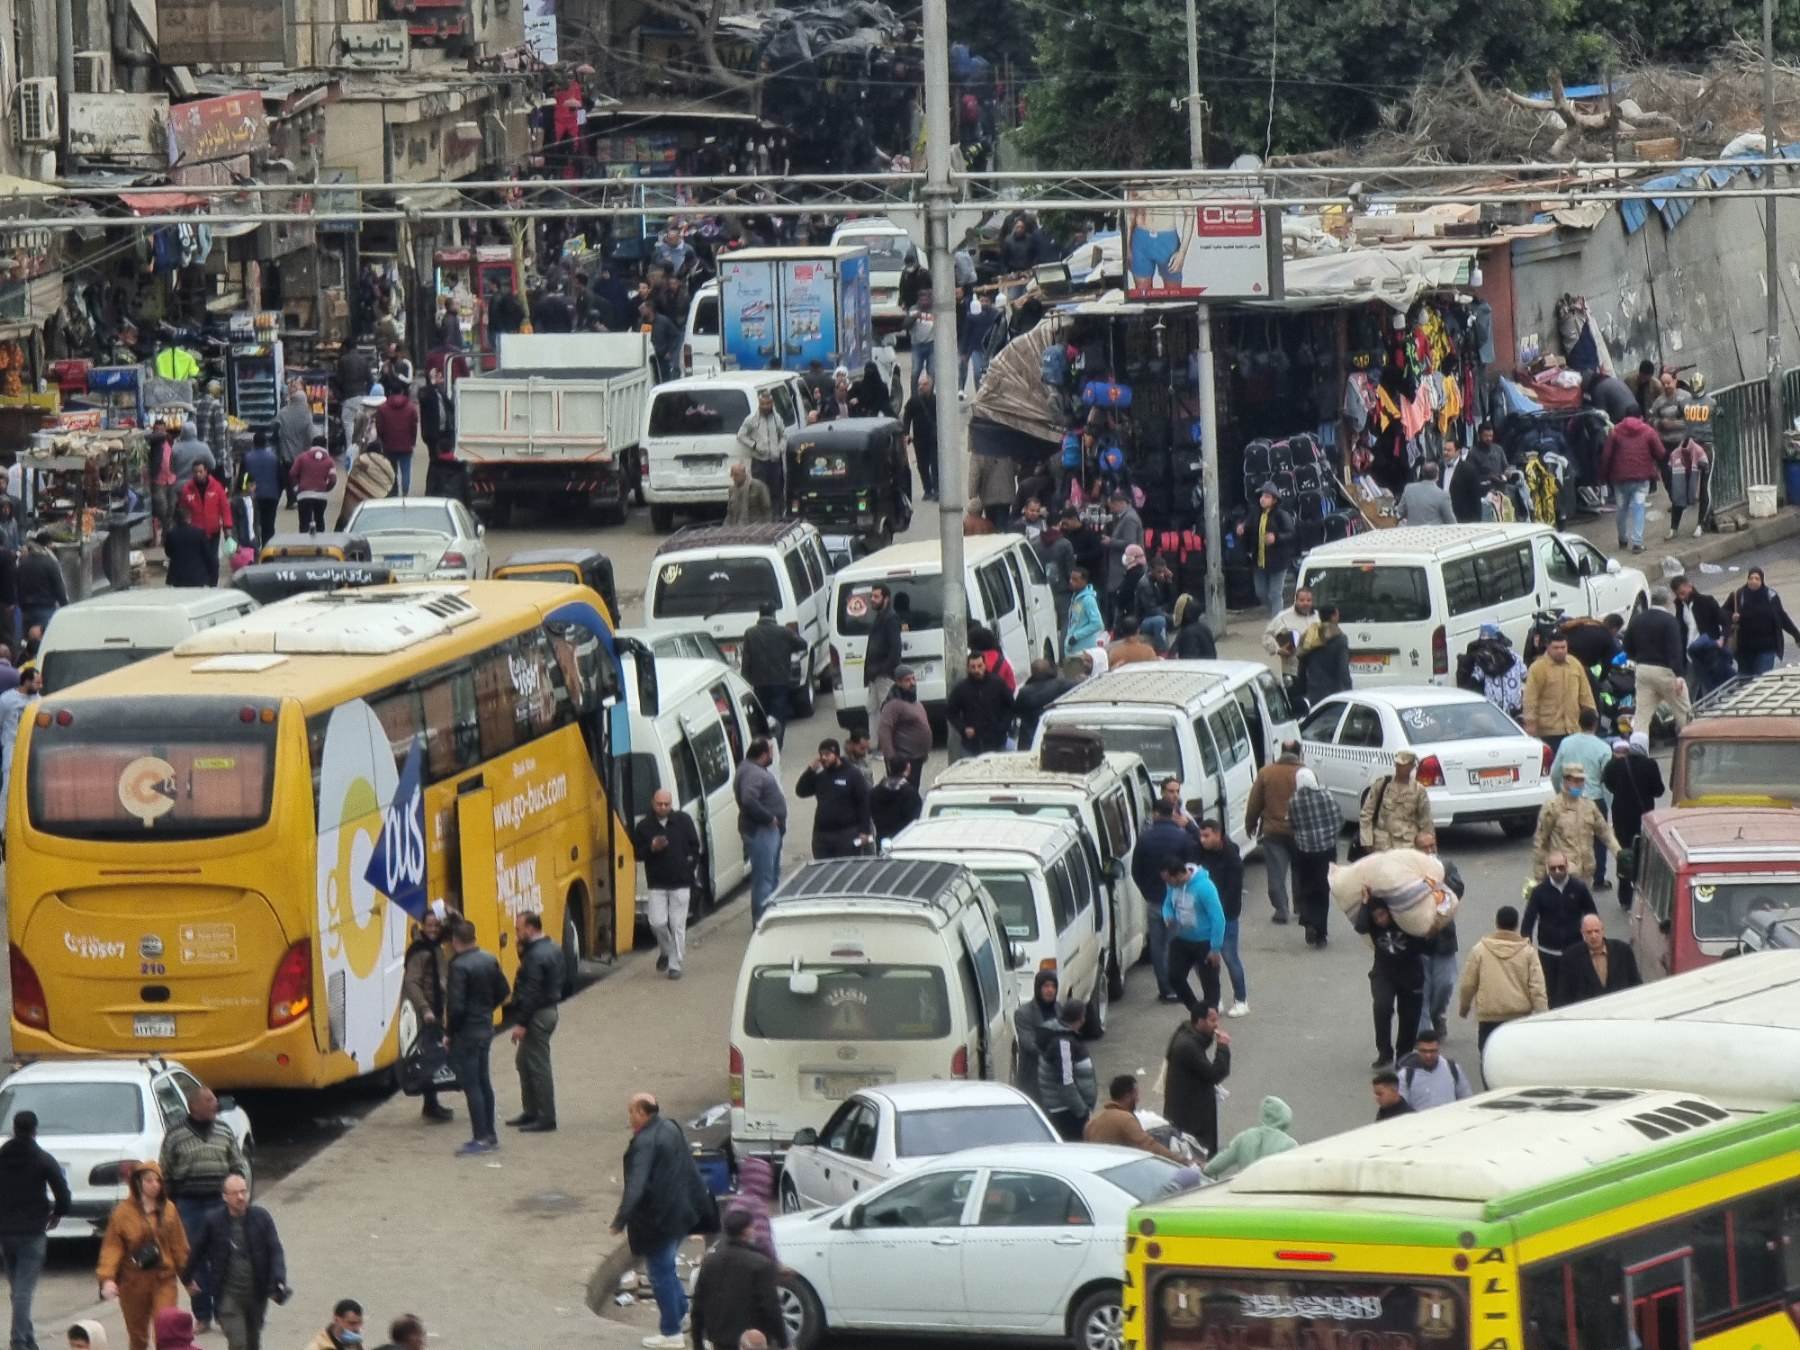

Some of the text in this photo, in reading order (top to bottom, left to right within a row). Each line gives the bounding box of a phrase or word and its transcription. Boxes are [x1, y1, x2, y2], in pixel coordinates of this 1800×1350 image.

[1683, 404, 1710, 422] GOLD
[493, 773, 567, 832] ww.go-bus.com
[141, 963, 165, 975] 210
